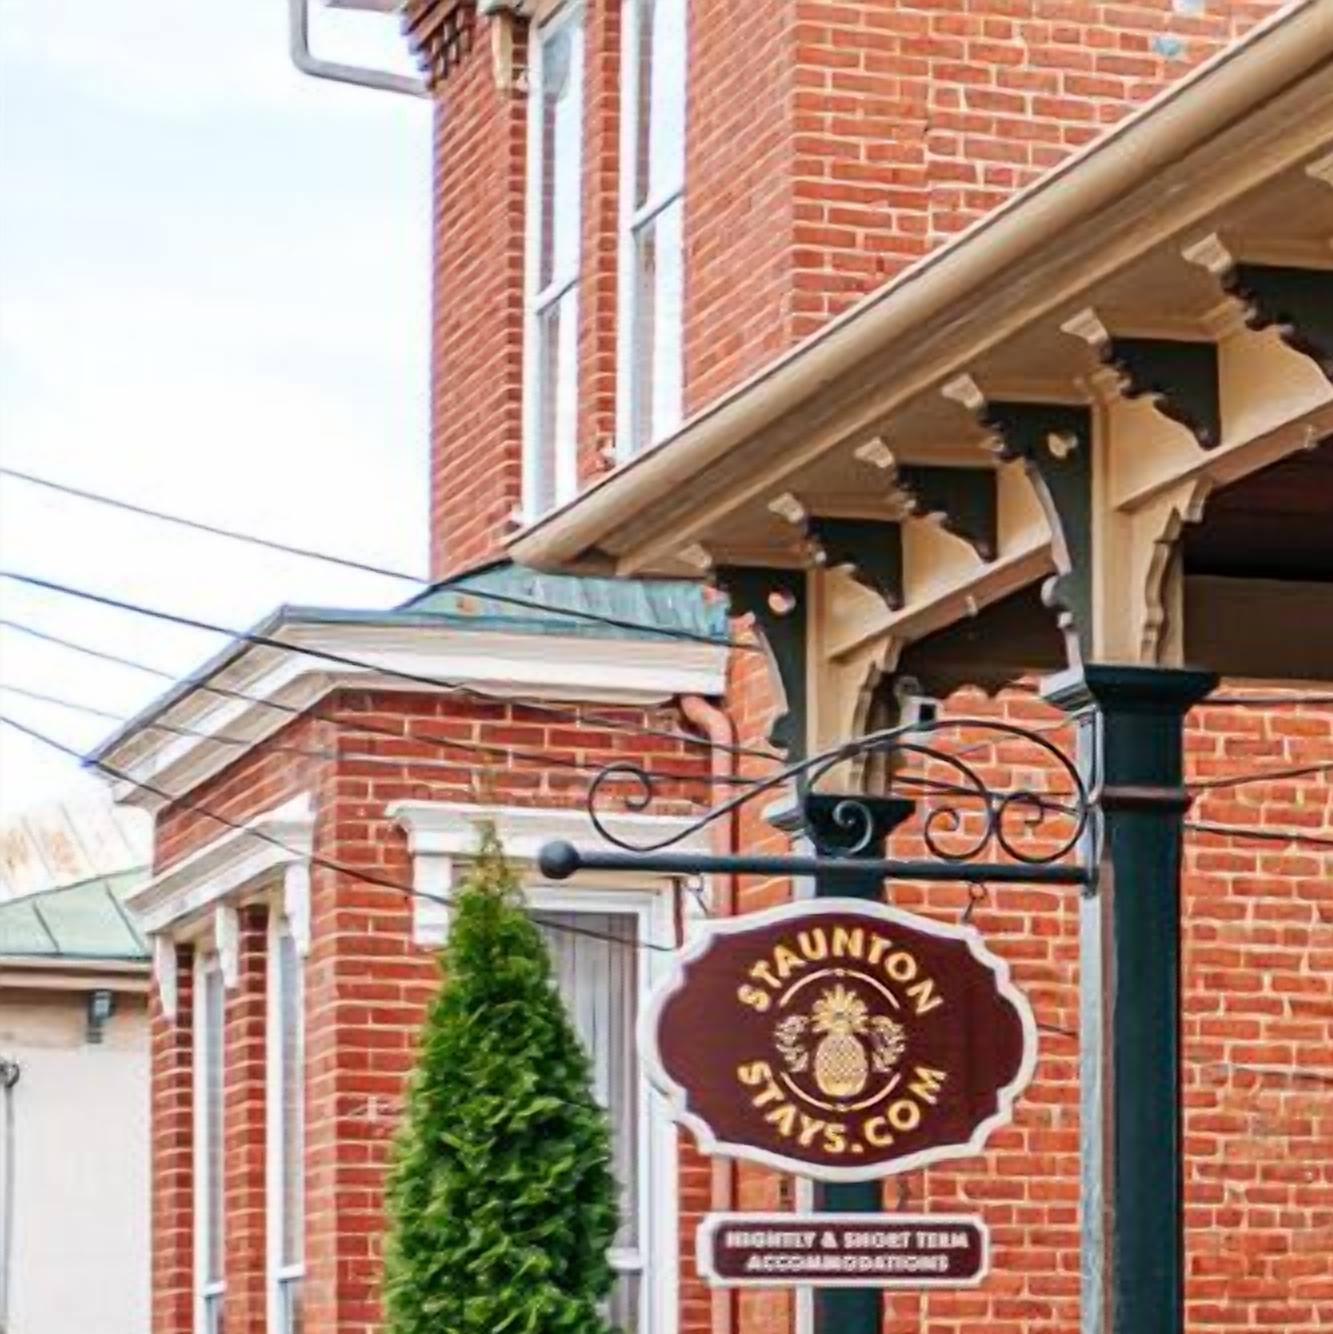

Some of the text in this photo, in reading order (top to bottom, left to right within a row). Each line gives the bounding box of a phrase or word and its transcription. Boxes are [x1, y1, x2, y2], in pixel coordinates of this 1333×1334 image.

[738, 927, 944, 1015] STAUNTON
[738, 1060, 947, 1153] STAYS.COM
[726, 1231, 969, 1249] NIGHTLY & SHORT TERM
